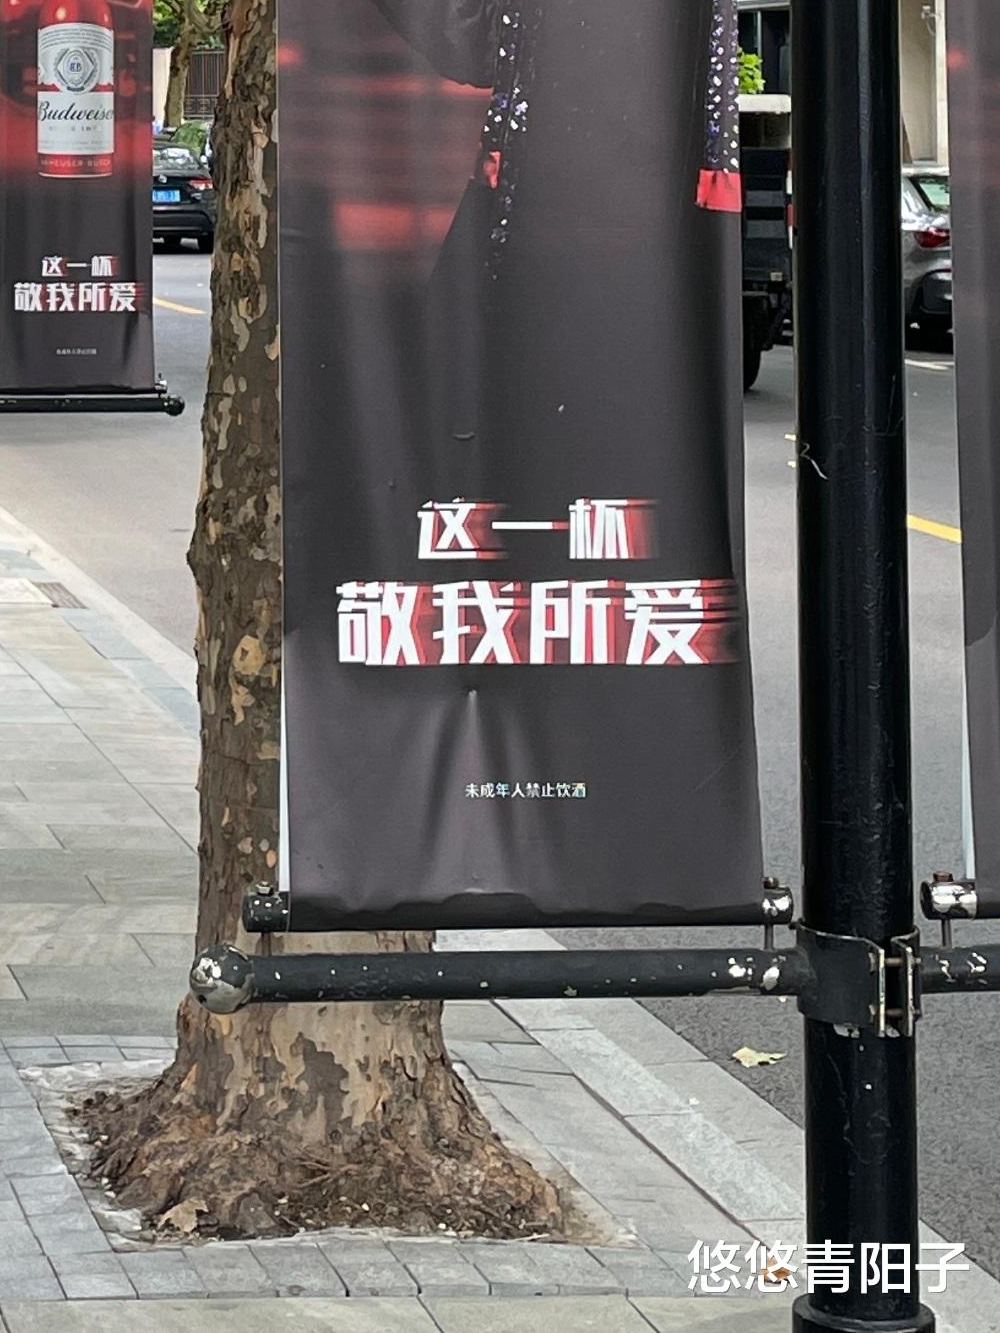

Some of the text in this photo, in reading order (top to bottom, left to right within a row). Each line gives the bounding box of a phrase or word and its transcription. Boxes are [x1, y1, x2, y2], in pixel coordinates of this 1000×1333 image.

[42, 255, 116, 277] 这一杯
[13, 281, 140, 312] 敬我所爱
[417, 497, 650, 560] 这一杯
[336, 580, 724, 665] 敬我所爱
[464, 782, 587, 798] 未成年人禁止饮酒
